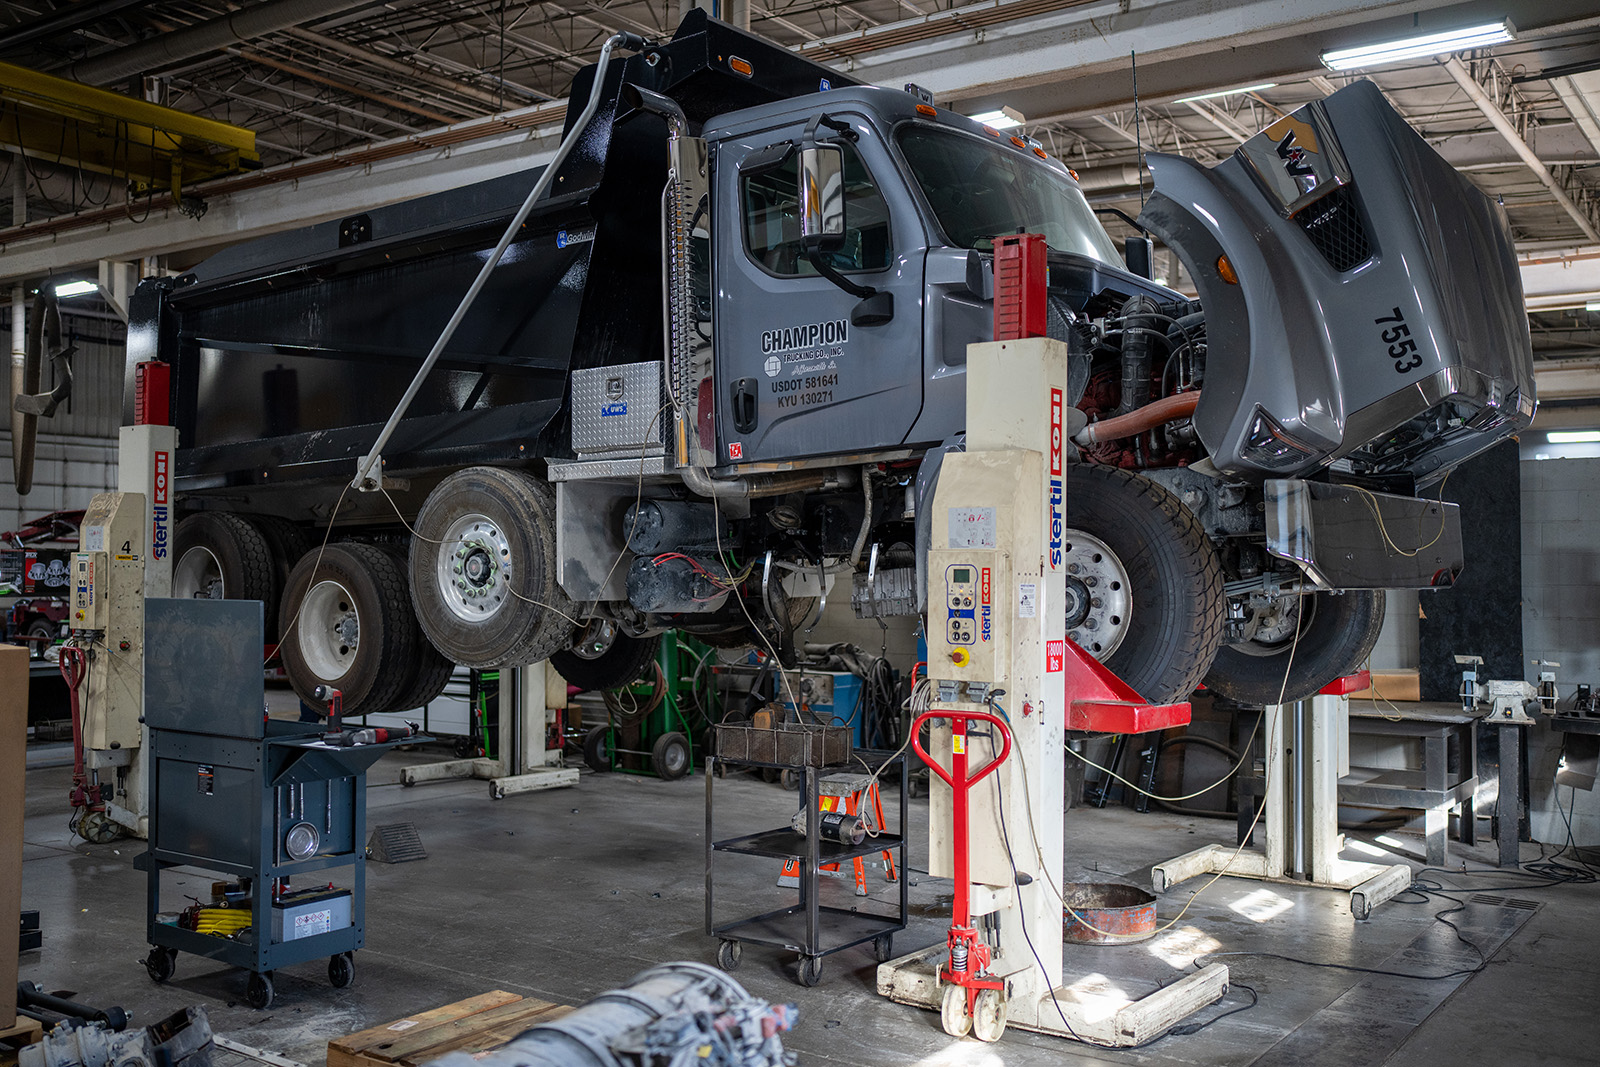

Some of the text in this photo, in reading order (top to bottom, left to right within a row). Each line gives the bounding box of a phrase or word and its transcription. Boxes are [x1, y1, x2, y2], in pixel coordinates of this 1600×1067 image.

[567, 230, 594, 243] Godwin
[761, 319, 848, 354] CHAMPION
[1374, 306, 1423, 375] 7553
[784, 350, 814, 364] TRUCKING
[771, 373, 838, 393] USDOT 581641
[777, 390, 833, 408] KYU 130271
[1049, 393, 1063, 570] stertil KONI
[153, 453, 168, 561] stertil KONI
[121, 540, 131, 554] 4
[981, 568, 991, 643] stertil KONI
[1050, 657, 1059, 671] lbs
